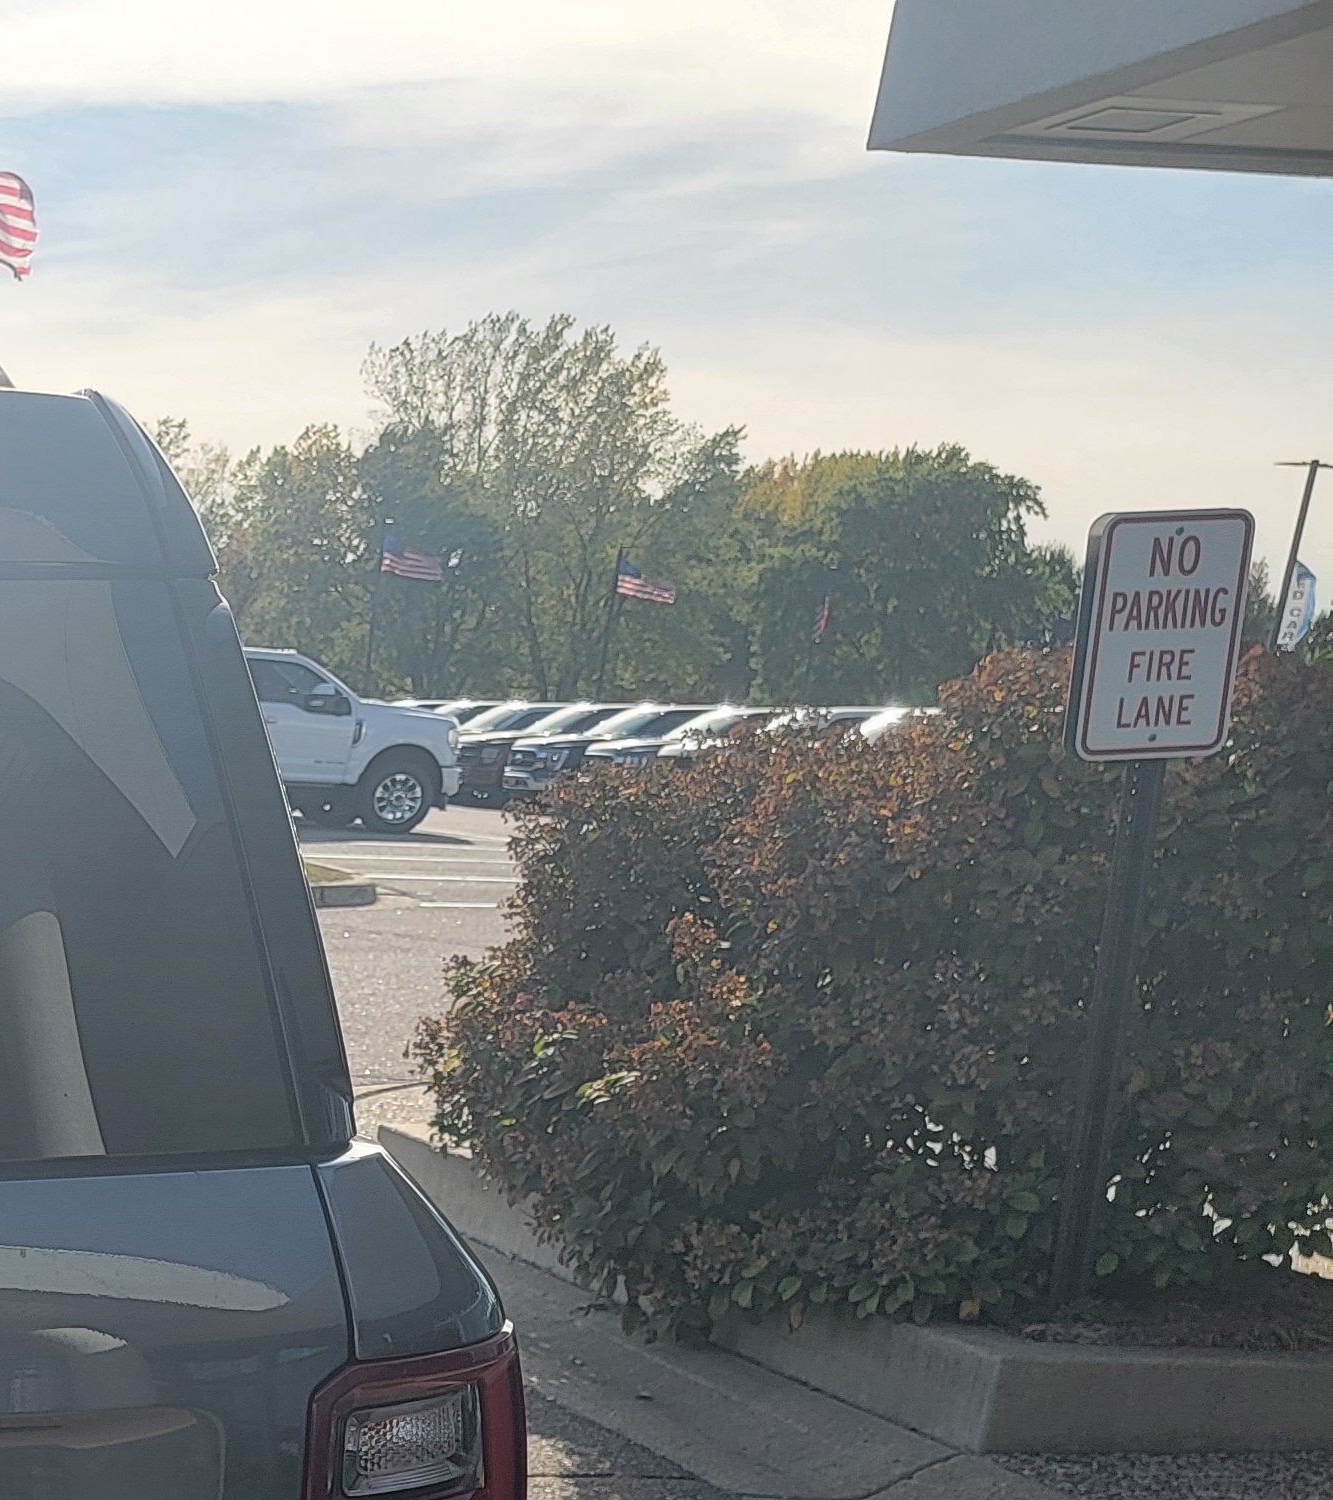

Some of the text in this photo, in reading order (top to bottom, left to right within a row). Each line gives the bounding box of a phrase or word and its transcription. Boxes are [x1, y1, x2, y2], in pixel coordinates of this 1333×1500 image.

[1148, 535, 1201, 577] NO
[1108, 587, 1229, 632] PARKING
[1127, 649, 1196, 683] FIRE
[1116, 694, 1195, 729] LANE
